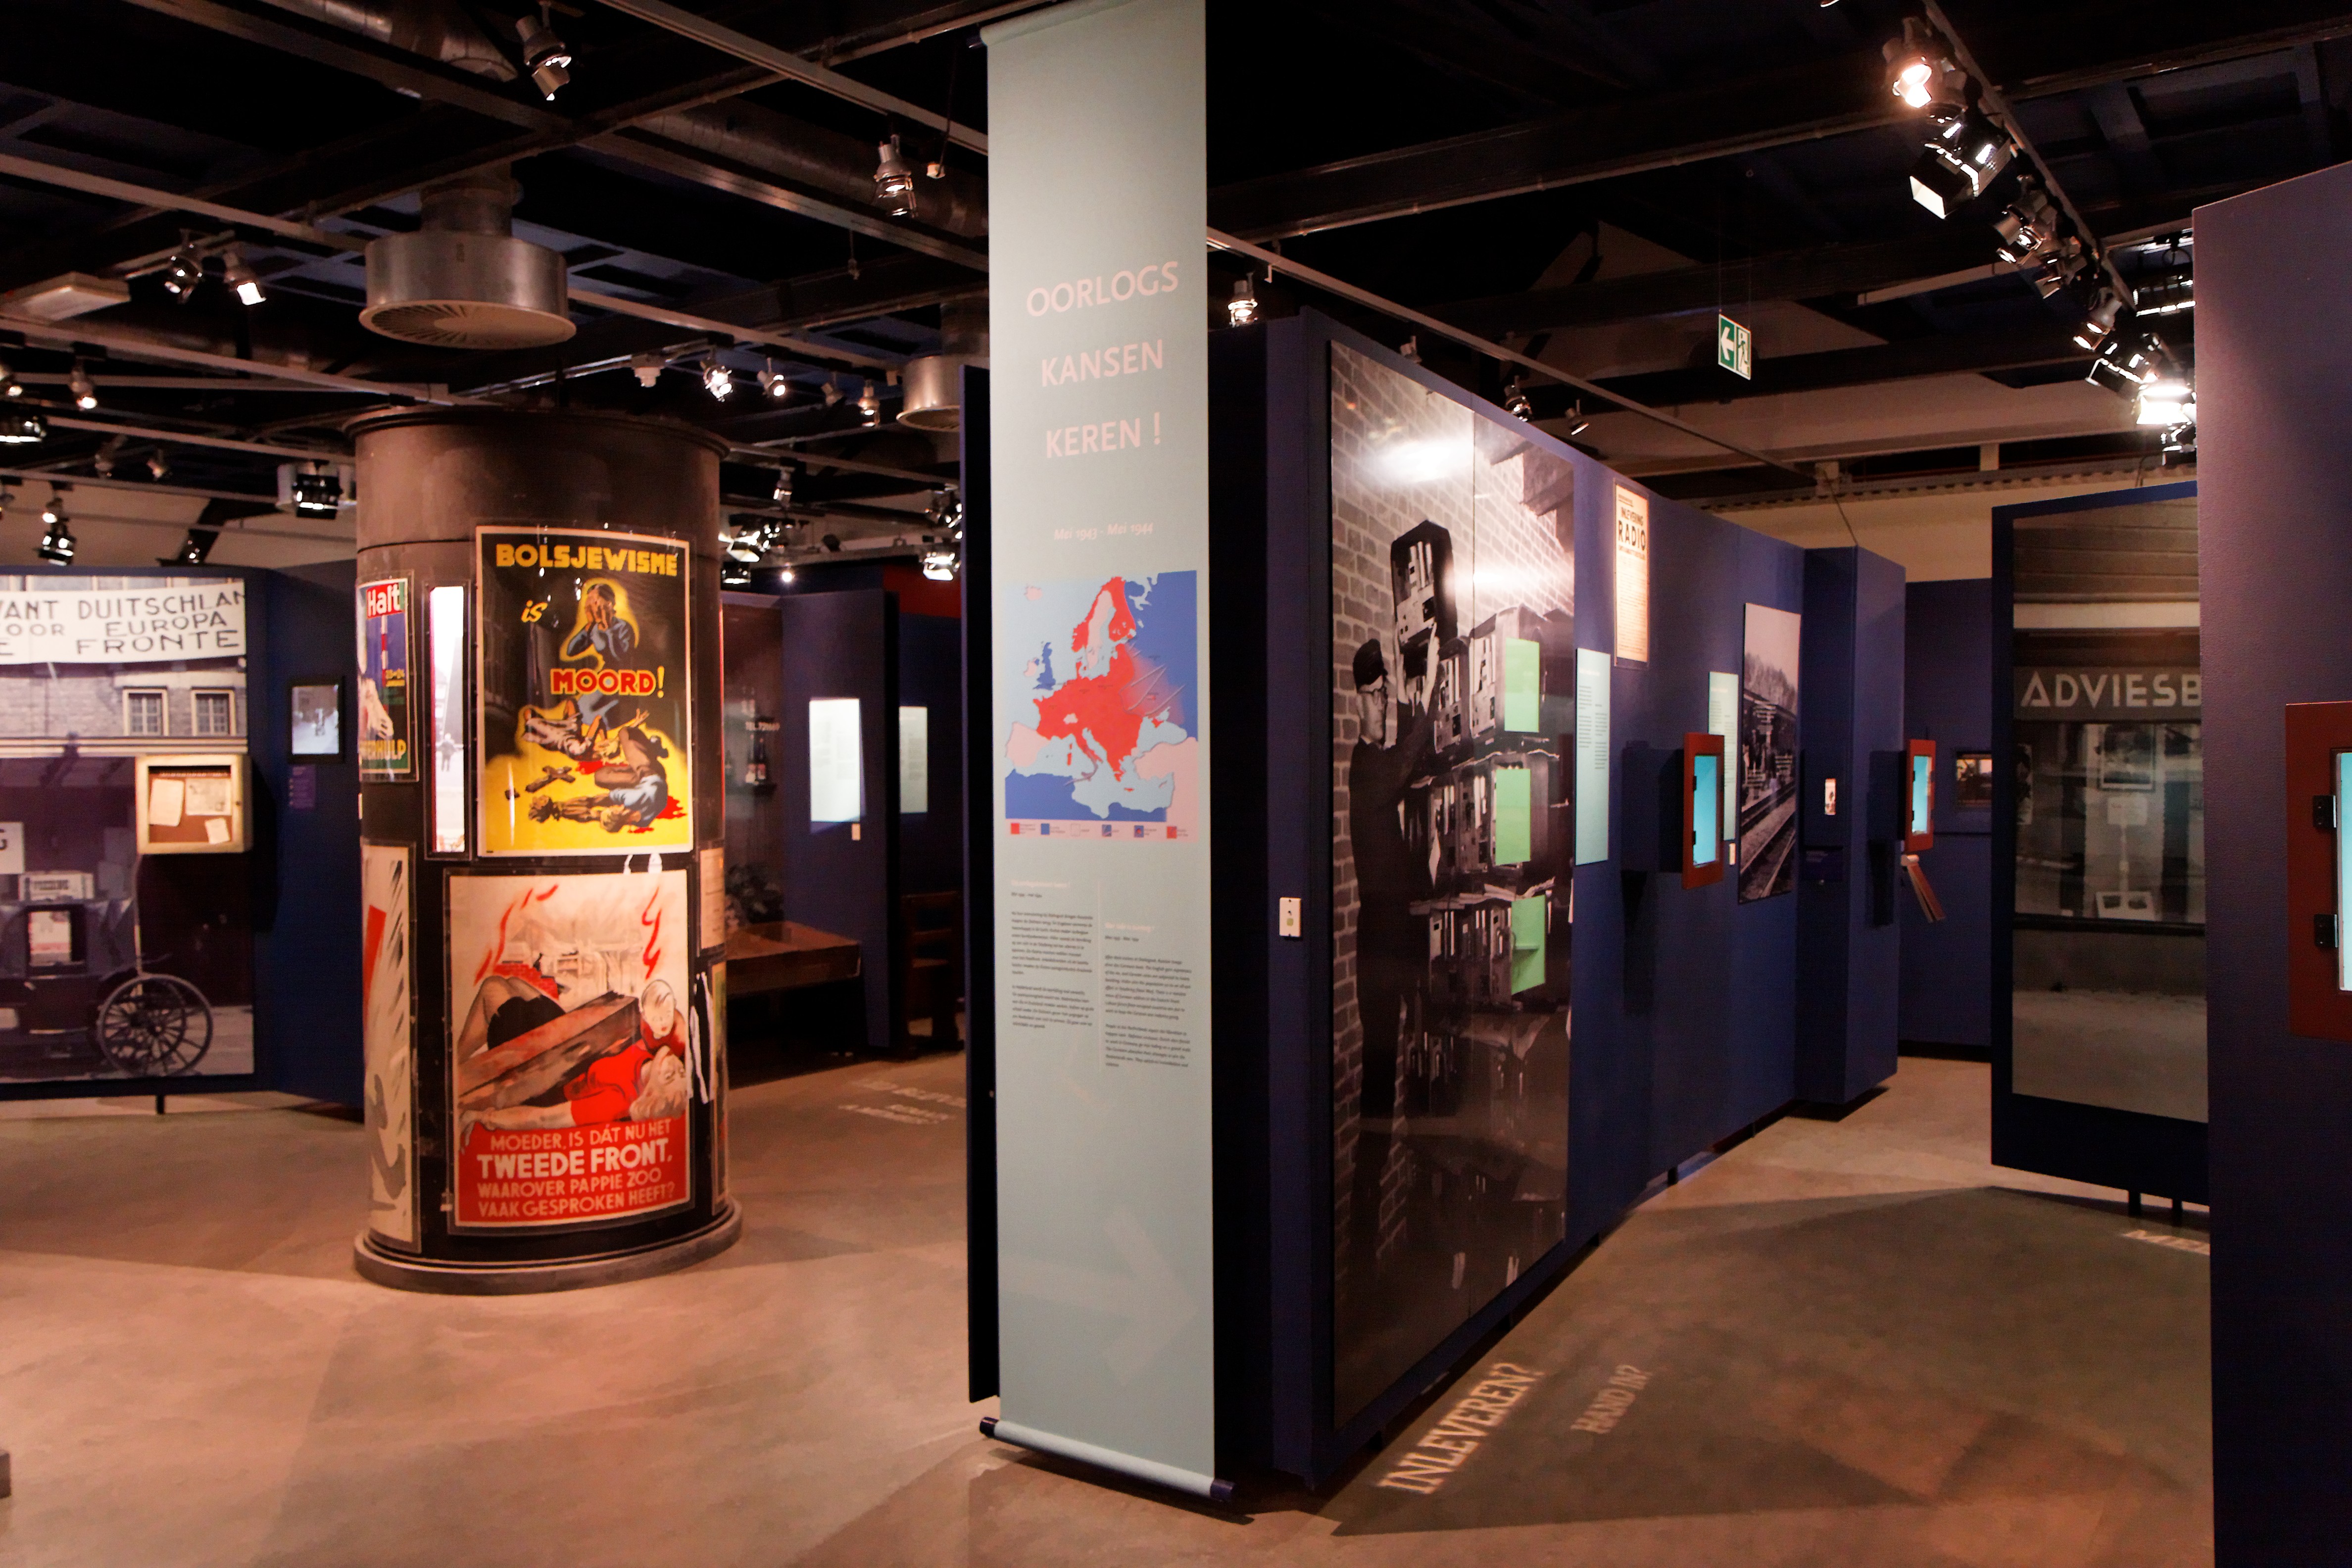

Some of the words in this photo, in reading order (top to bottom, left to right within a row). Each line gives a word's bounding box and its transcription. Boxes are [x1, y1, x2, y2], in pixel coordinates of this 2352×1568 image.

[1027, 261, 1178, 317] OORLOGS
[1042, 339, 1163, 387] KANSEN
[1046, 418, 1140, 458] KEREN
[1054, 528, 1073, 540] Mei
[1076, 528, 1097, 540] 1943
[1107, 522, 1127, 535] Mei
[1130, 523, 1153, 536] 1944
[1618, 520, 1646, 550] RADIO
[496, 544, 677, 576] BOLSJEWISME
[0, 600, 59, 620] ANT
[368, 584, 400, 617] Halt
[521, 600, 547, 623] is
[105, 611, 227, 637] EUROPA
[77, 630, 239, 655] FRONTE
[550, 666, 665, 698] MOORD!
[2020, 671, 2202, 708] ADVIESB
[491, 1134, 567, 1151] MOEDER,
[569, 1132, 583, 1147] IS
[626, 1125, 645, 1140] NU
[649, 1119, 671, 1137] HET
[477, 1150, 585, 1178] TWEEDE
[591, 1139, 672, 1173] FRONT,
[477, 1180, 565, 1199] WAAROVER
[570, 1174, 623, 1194] PAPPIE
[627, 1168, 661, 1187] ZOO
[478, 1200, 520, 1217] VAAK
[523, 1192, 624, 1216] GESPROKEN
[629, 1181, 675, 1206] HEEFT?
[1377, 1362, 1547, 1495] INLEVEREN?
